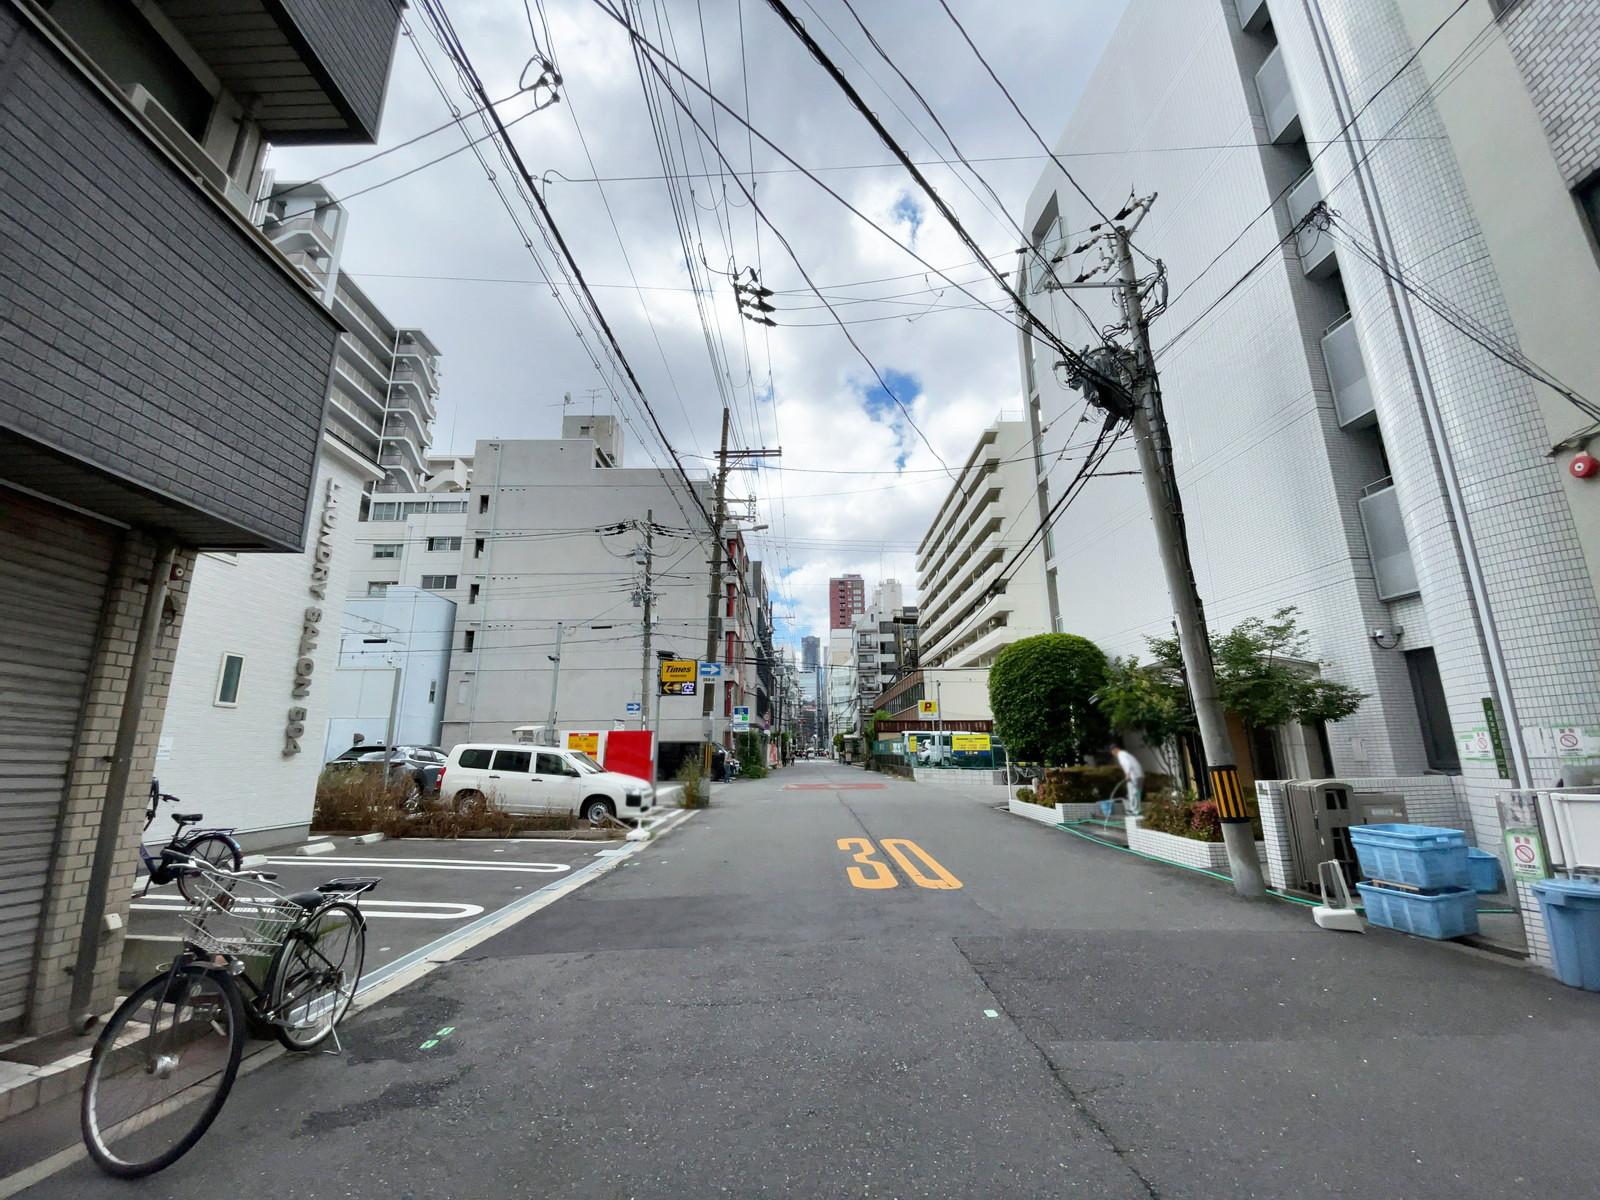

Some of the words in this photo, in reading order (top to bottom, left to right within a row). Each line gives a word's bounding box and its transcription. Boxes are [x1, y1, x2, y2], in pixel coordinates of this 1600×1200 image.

[310, 477, 342, 600] LAUNDRY
[292, 606, 322, 699] SALON
[666, 665, 692, 673] Times
[682, 681, 695, 694] 空
[924, 702, 932, 712] P
[283, 706, 308, 757] 504
[836, 838, 963, 889] 30
